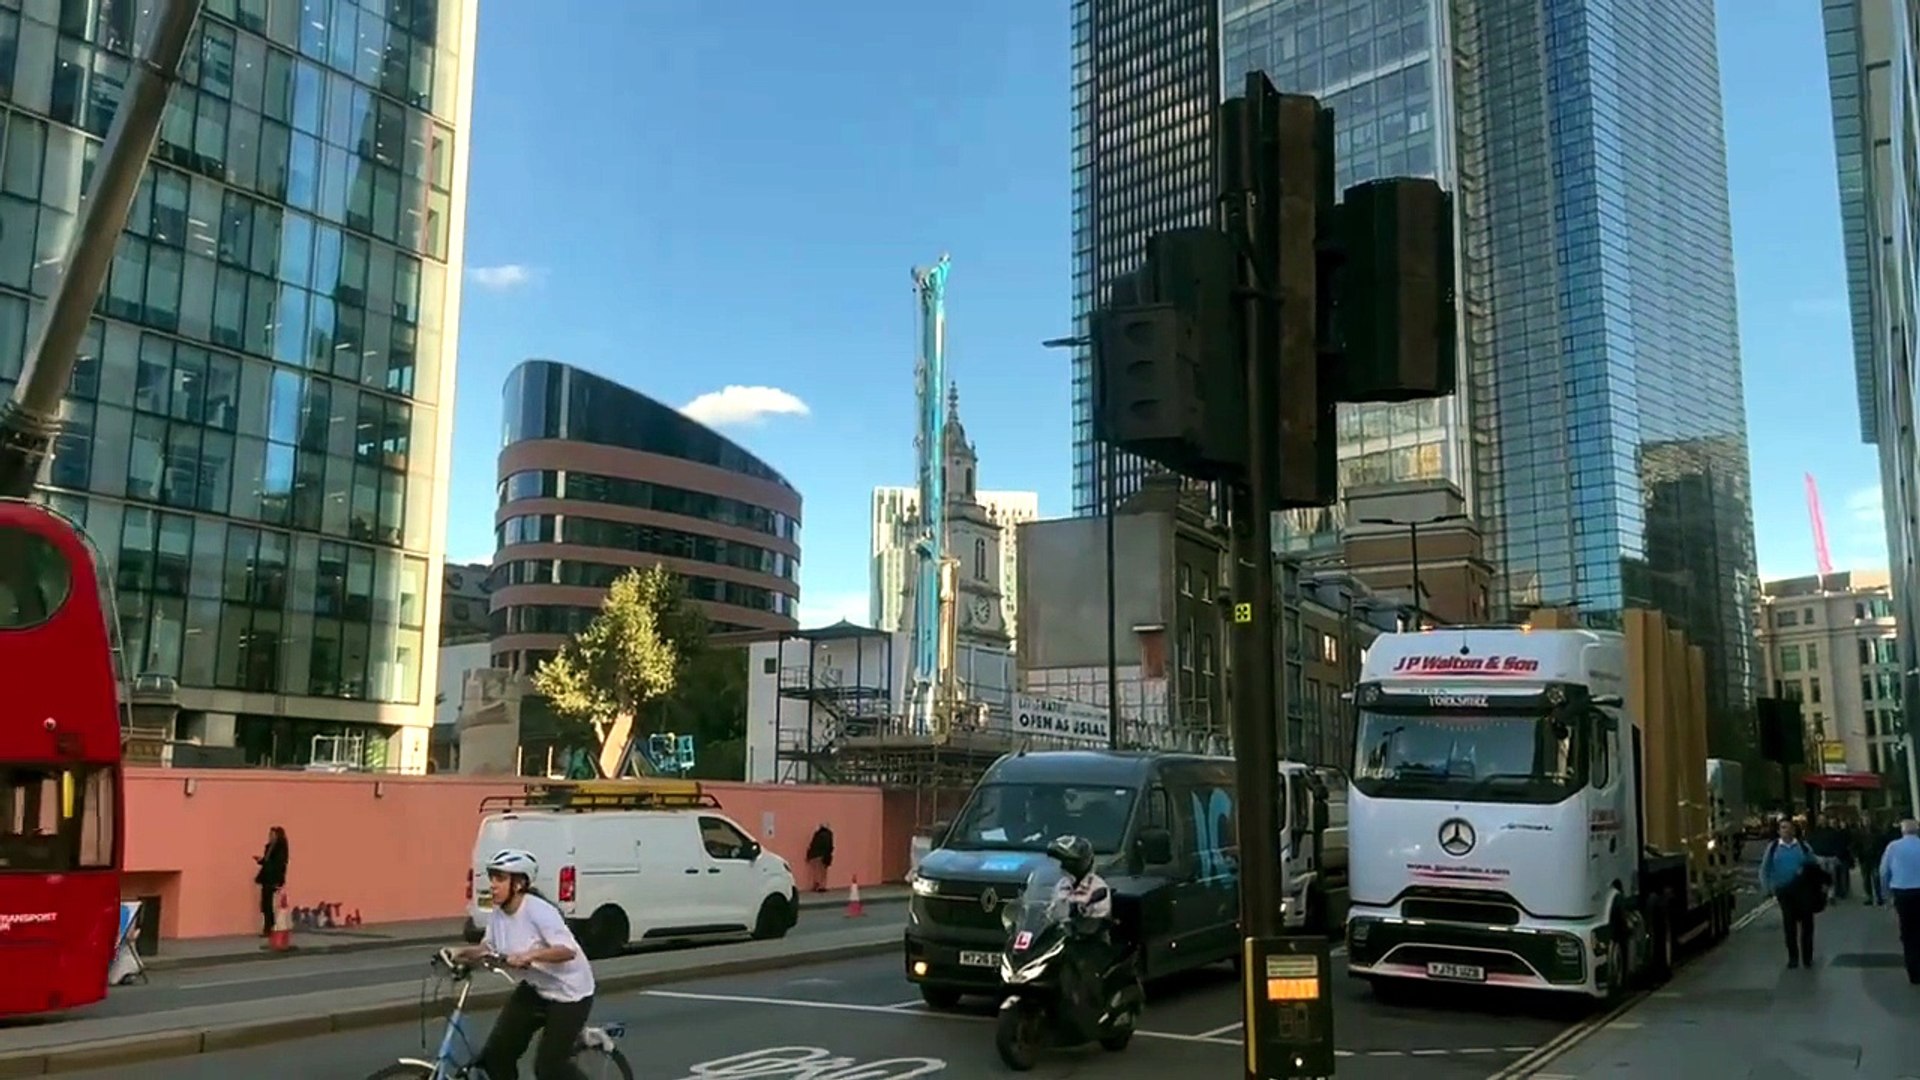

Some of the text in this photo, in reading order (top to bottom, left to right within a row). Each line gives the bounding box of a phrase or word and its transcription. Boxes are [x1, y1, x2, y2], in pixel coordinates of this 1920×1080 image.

[1393, 655, 1539, 671] J P Walton & Son
